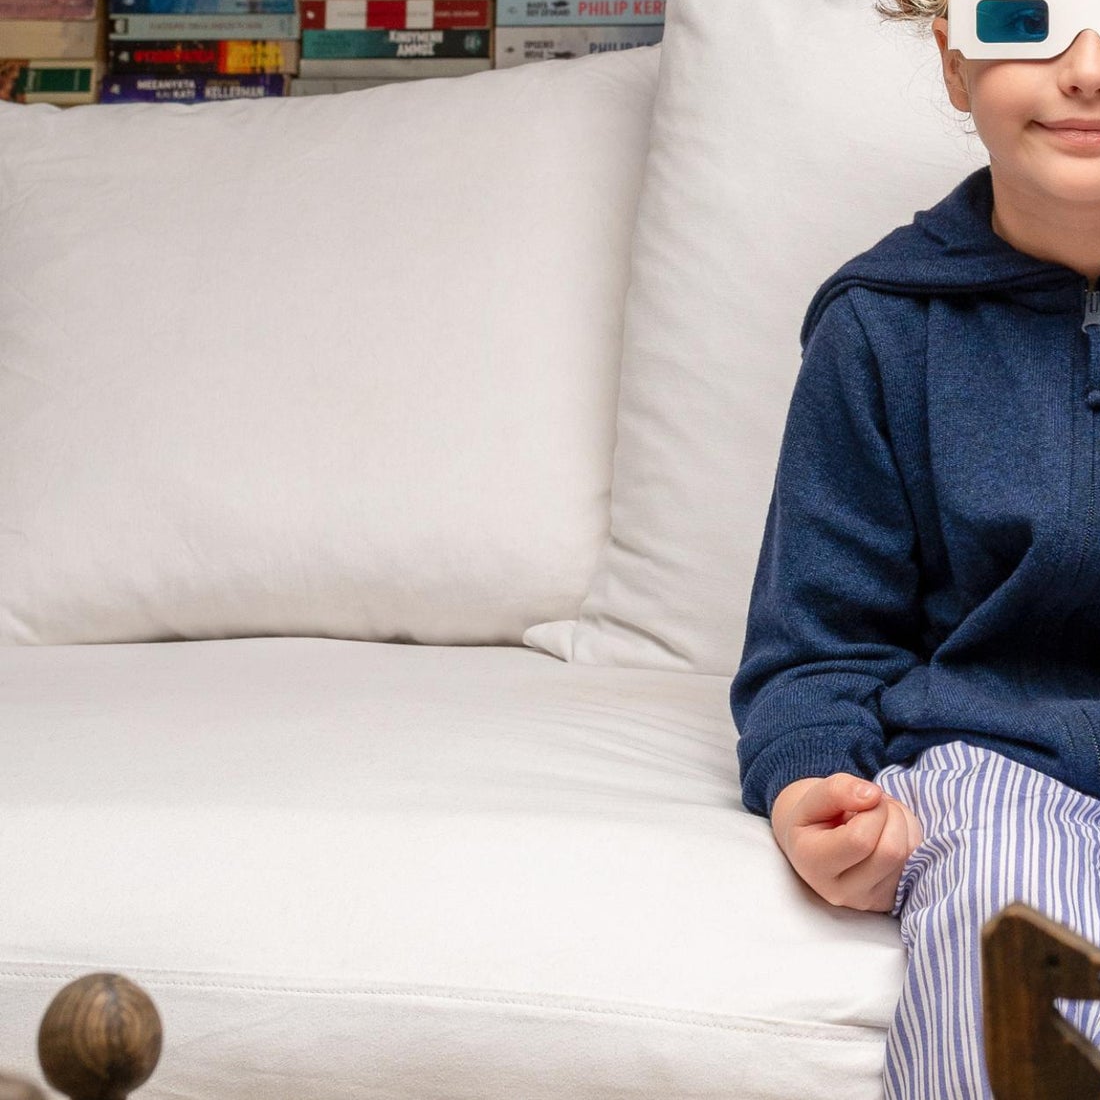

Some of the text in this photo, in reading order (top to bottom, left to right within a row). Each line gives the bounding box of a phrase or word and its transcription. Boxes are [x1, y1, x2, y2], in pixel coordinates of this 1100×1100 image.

[578, 1, 629, 17] PHILIP
[633, 0, 665, 16] KER
[204, 86, 266, 99] KELLERMAN
